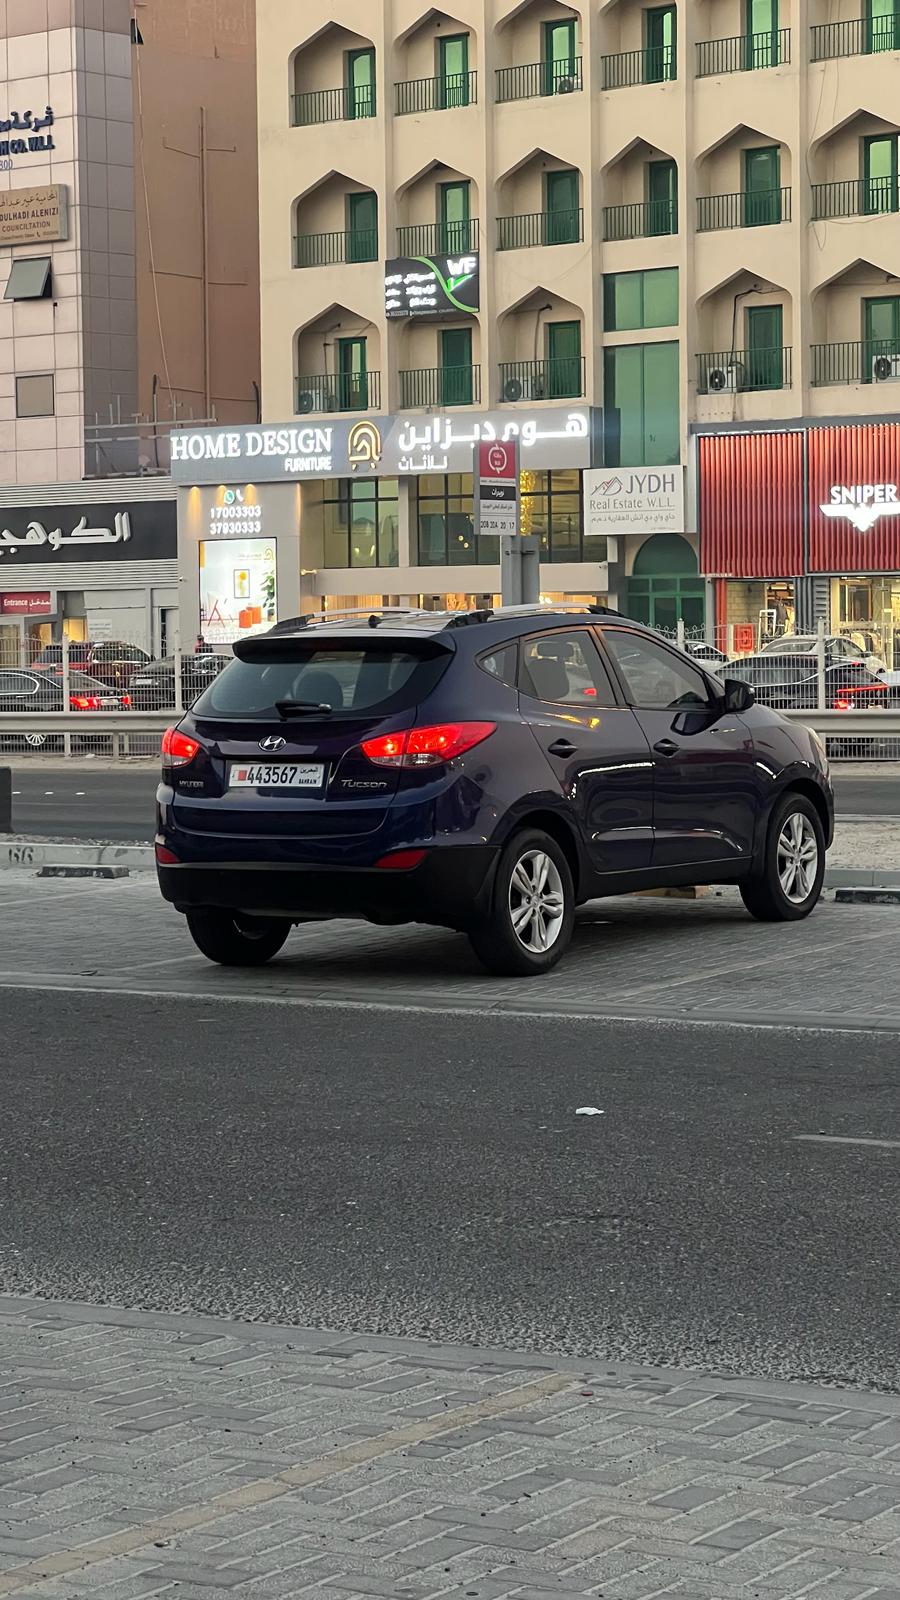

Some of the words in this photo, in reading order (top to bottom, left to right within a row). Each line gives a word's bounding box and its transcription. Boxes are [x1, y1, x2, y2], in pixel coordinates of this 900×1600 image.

[31, 207, 58, 218] ALENIZI
[447, 257, 476, 275] WF
[171, 433, 241, 460] HOME
[245, 428, 333, 455] DESIGN
[284, 456, 332, 472] FURNITURE
[625, 473, 675, 494] JYDH
[830, 484, 900, 505] SNIPER
[210, 505, 261, 519] 17003303
[589, 499, 610, 510] Real
[612, 498, 643, 510] Estate
[4, 599, 28, 607] Entrance
[247, 762, 297, 784] 443567
